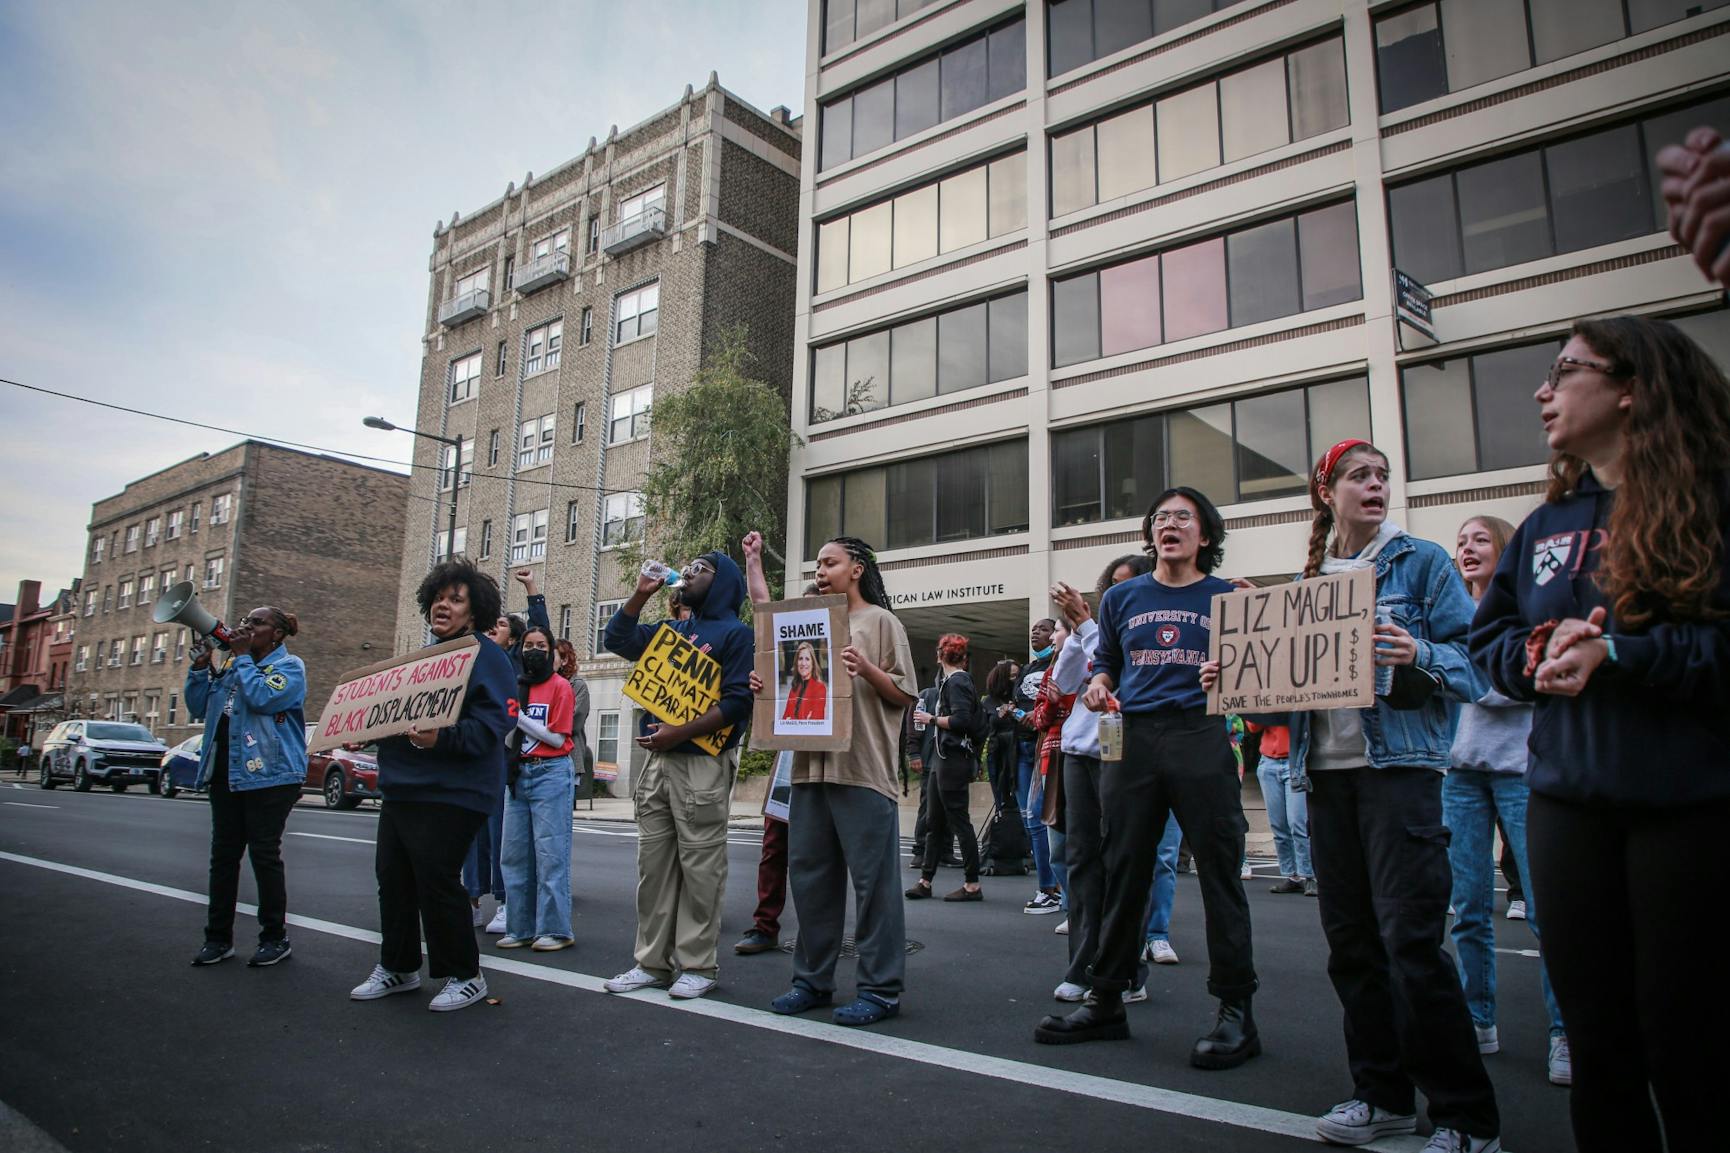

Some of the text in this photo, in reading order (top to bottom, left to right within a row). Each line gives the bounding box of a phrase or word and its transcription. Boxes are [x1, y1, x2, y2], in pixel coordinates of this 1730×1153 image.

[887, 583, 1005, 605] RICAN LAW INSTITUTE
[1128, 609, 1199, 630] UNIVERSITY
[1219, 579, 1369, 636] LIZ MAGILL,
[780, 622, 825, 639] SHAME
[333, 666, 408, 706] STUDENTS
[406, 652, 472, 686] AGAINST
[653, 628, 722, 692] PENN
[1218, 631, 1341, 694] PAY UP!
[324, 685, 464, 738] BLACK DISPLACEMENT
[1222, 688, 1359, 712] SAVE THE PEOPLE'S TOWNHOMES
